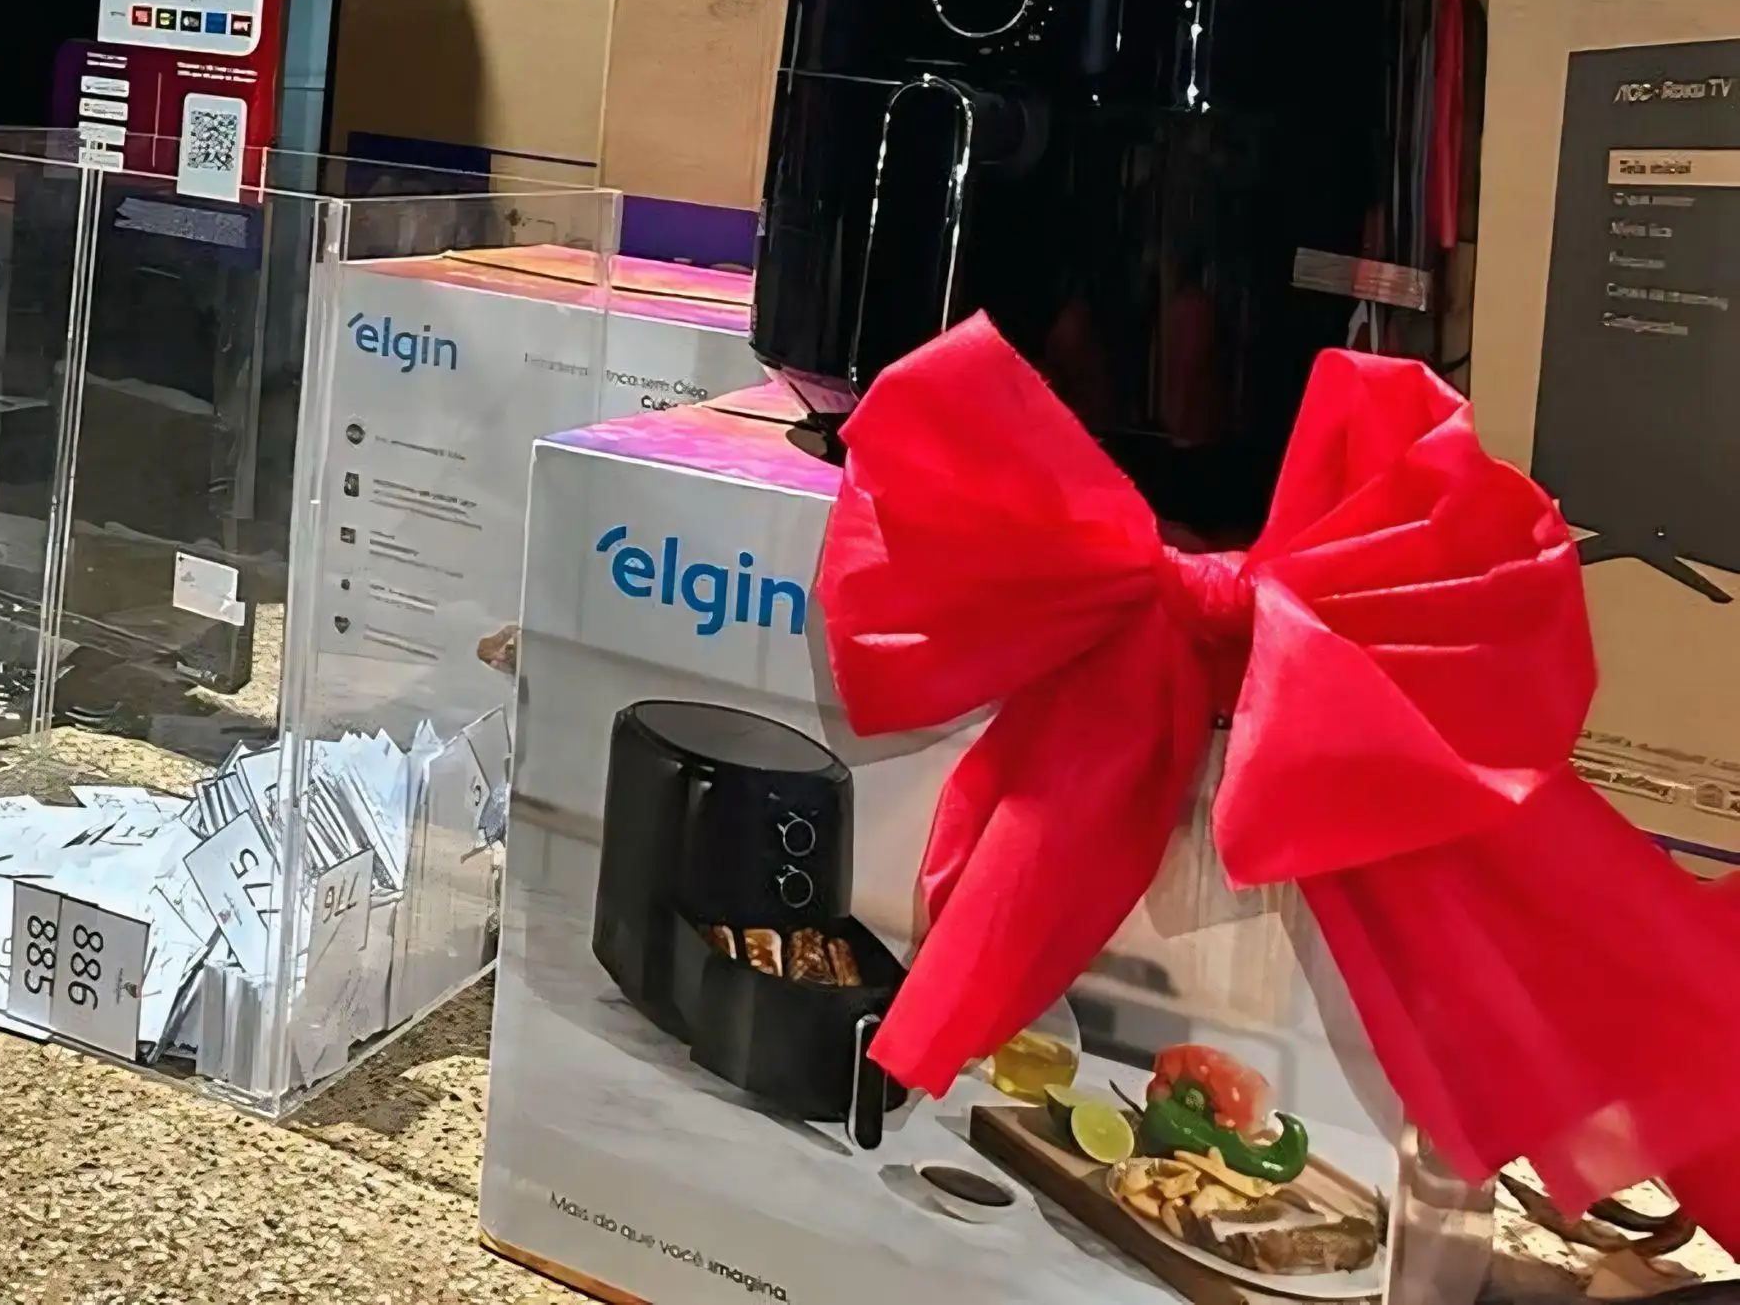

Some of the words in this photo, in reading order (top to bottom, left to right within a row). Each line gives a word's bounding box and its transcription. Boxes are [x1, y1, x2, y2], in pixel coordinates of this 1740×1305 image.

[348, 312, 458, 373] elgin
[596, 524, 807, 636] elgin
[23, 914, 59, 997] 885
[67, 923, 106, 1011] 886
